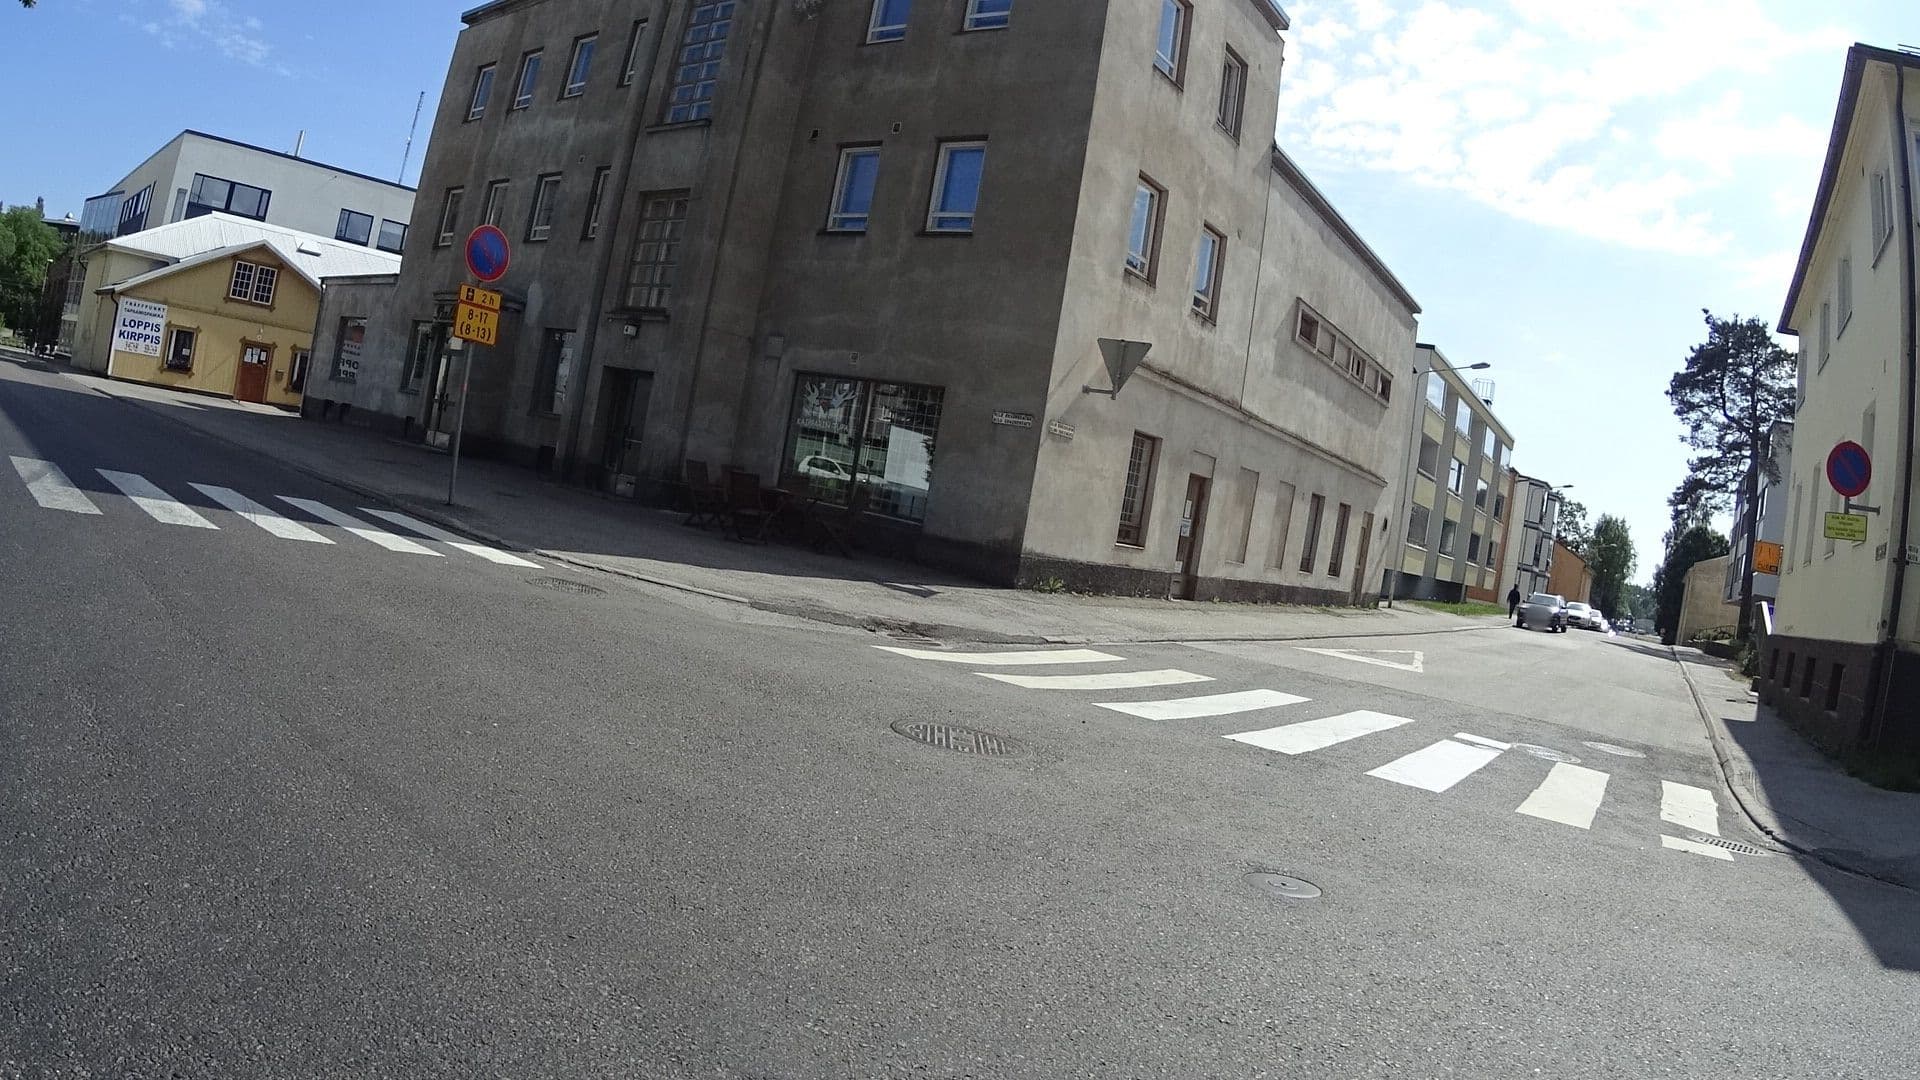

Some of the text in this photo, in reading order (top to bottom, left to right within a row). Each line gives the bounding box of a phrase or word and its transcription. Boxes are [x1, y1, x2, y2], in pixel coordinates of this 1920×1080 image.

[468, 309, 489, 324] 8-17
[122, 318, 161, 333] LOPPIS
[460, 321, 491, 342] (8-13)
[118, 329, 161, 345] KIRPPIS
